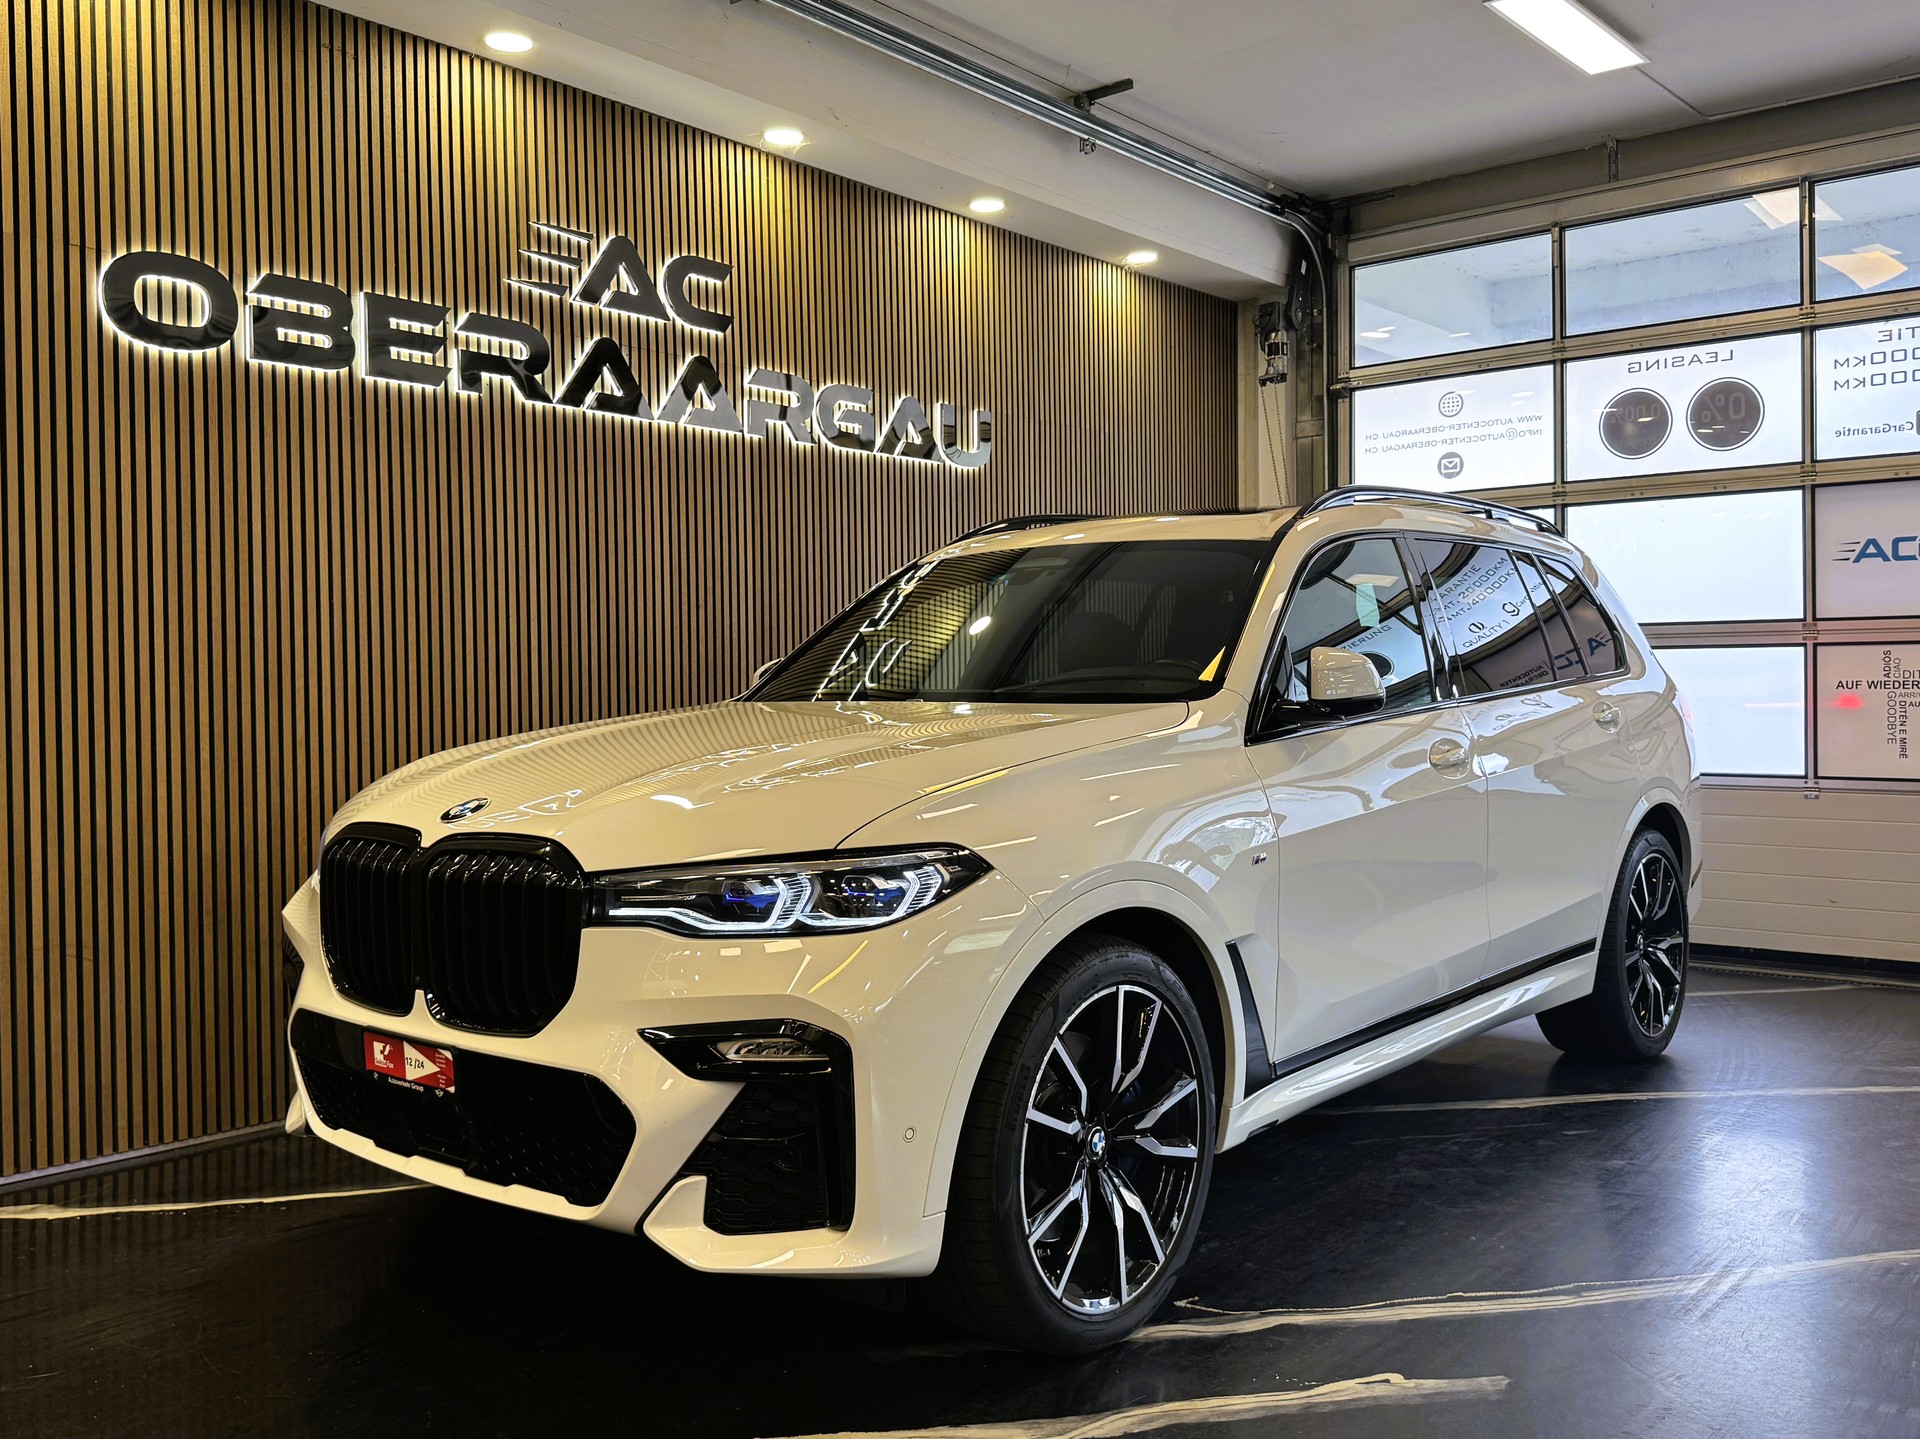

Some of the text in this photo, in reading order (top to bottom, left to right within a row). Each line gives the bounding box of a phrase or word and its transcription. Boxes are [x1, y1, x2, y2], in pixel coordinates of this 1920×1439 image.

[99, 251, 992, 470] OBERAARGAU
[1851, 535, 1920, 564] AC
[1893, 657, 1902, 679] CIAO
[1835, 680, 1920, 690] AUF WIEDER
[1887, 690, 1897, 745] GOODBYE
